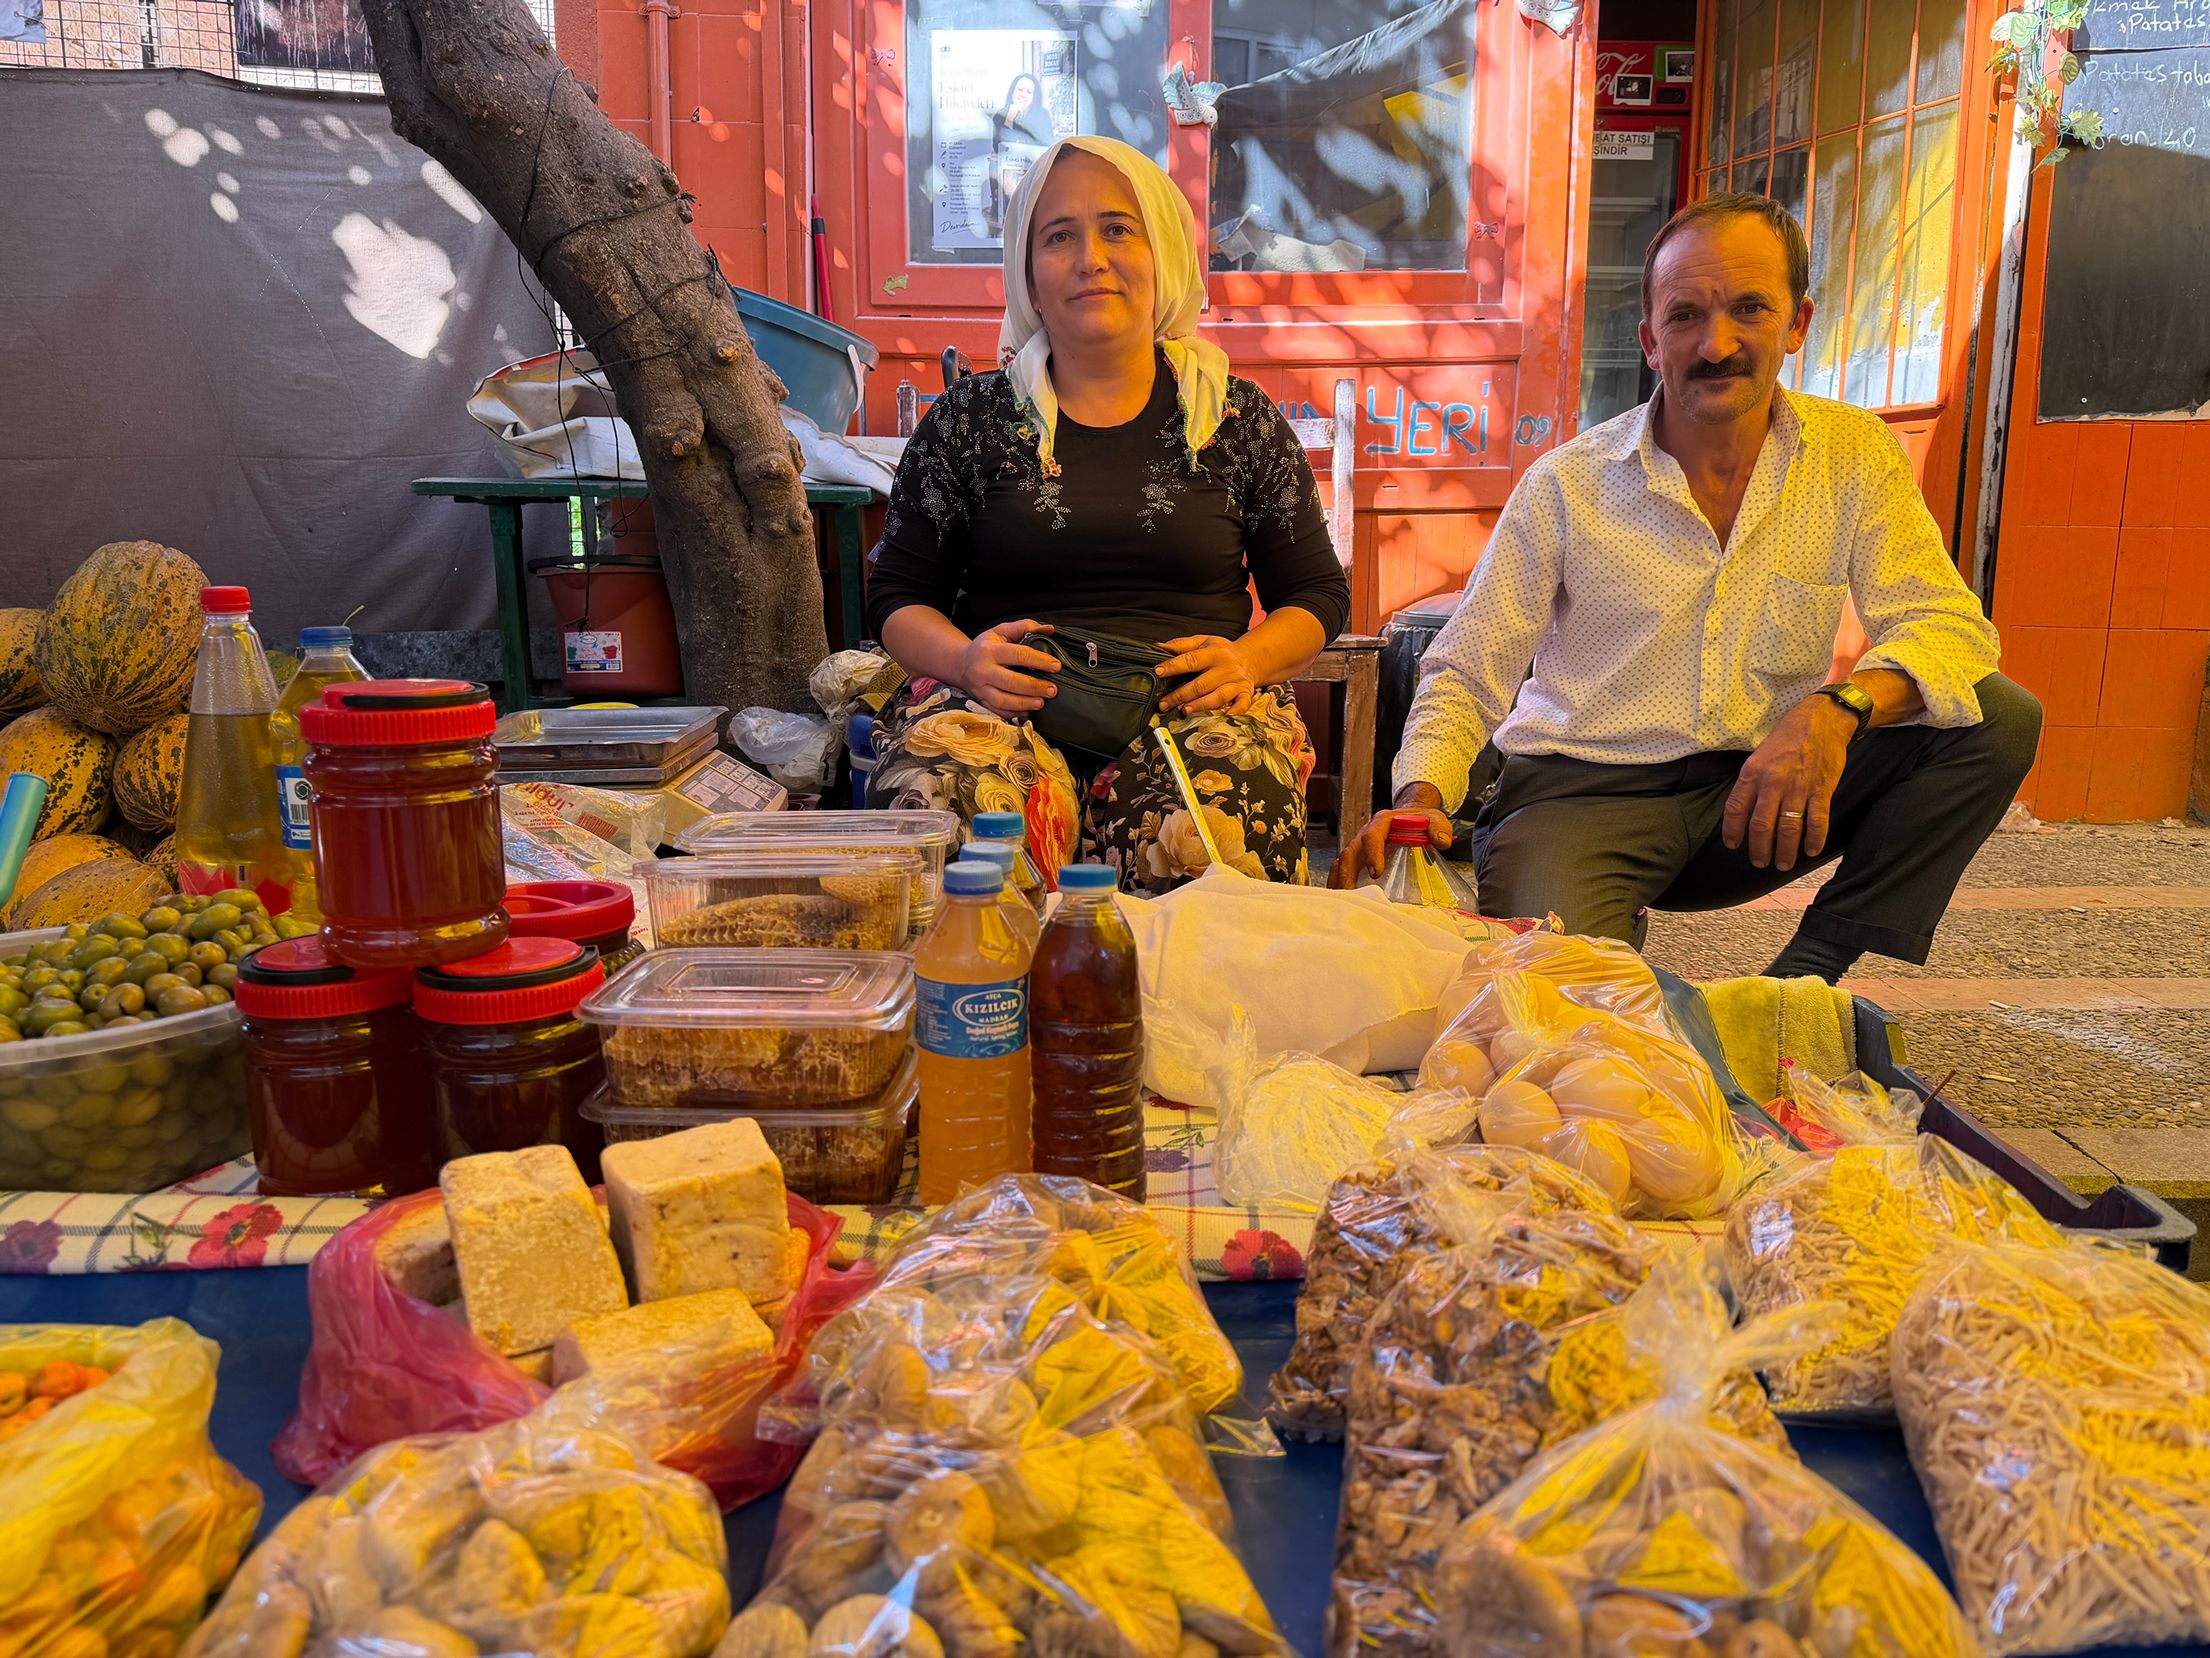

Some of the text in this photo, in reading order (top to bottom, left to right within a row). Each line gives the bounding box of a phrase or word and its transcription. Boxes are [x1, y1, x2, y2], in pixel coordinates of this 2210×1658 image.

[2085, 61, 2167, 82] Patates
[1618, 133, 1650, 145] SATIŞI
[964, 998, 1018, 1014] KIZILCIK
